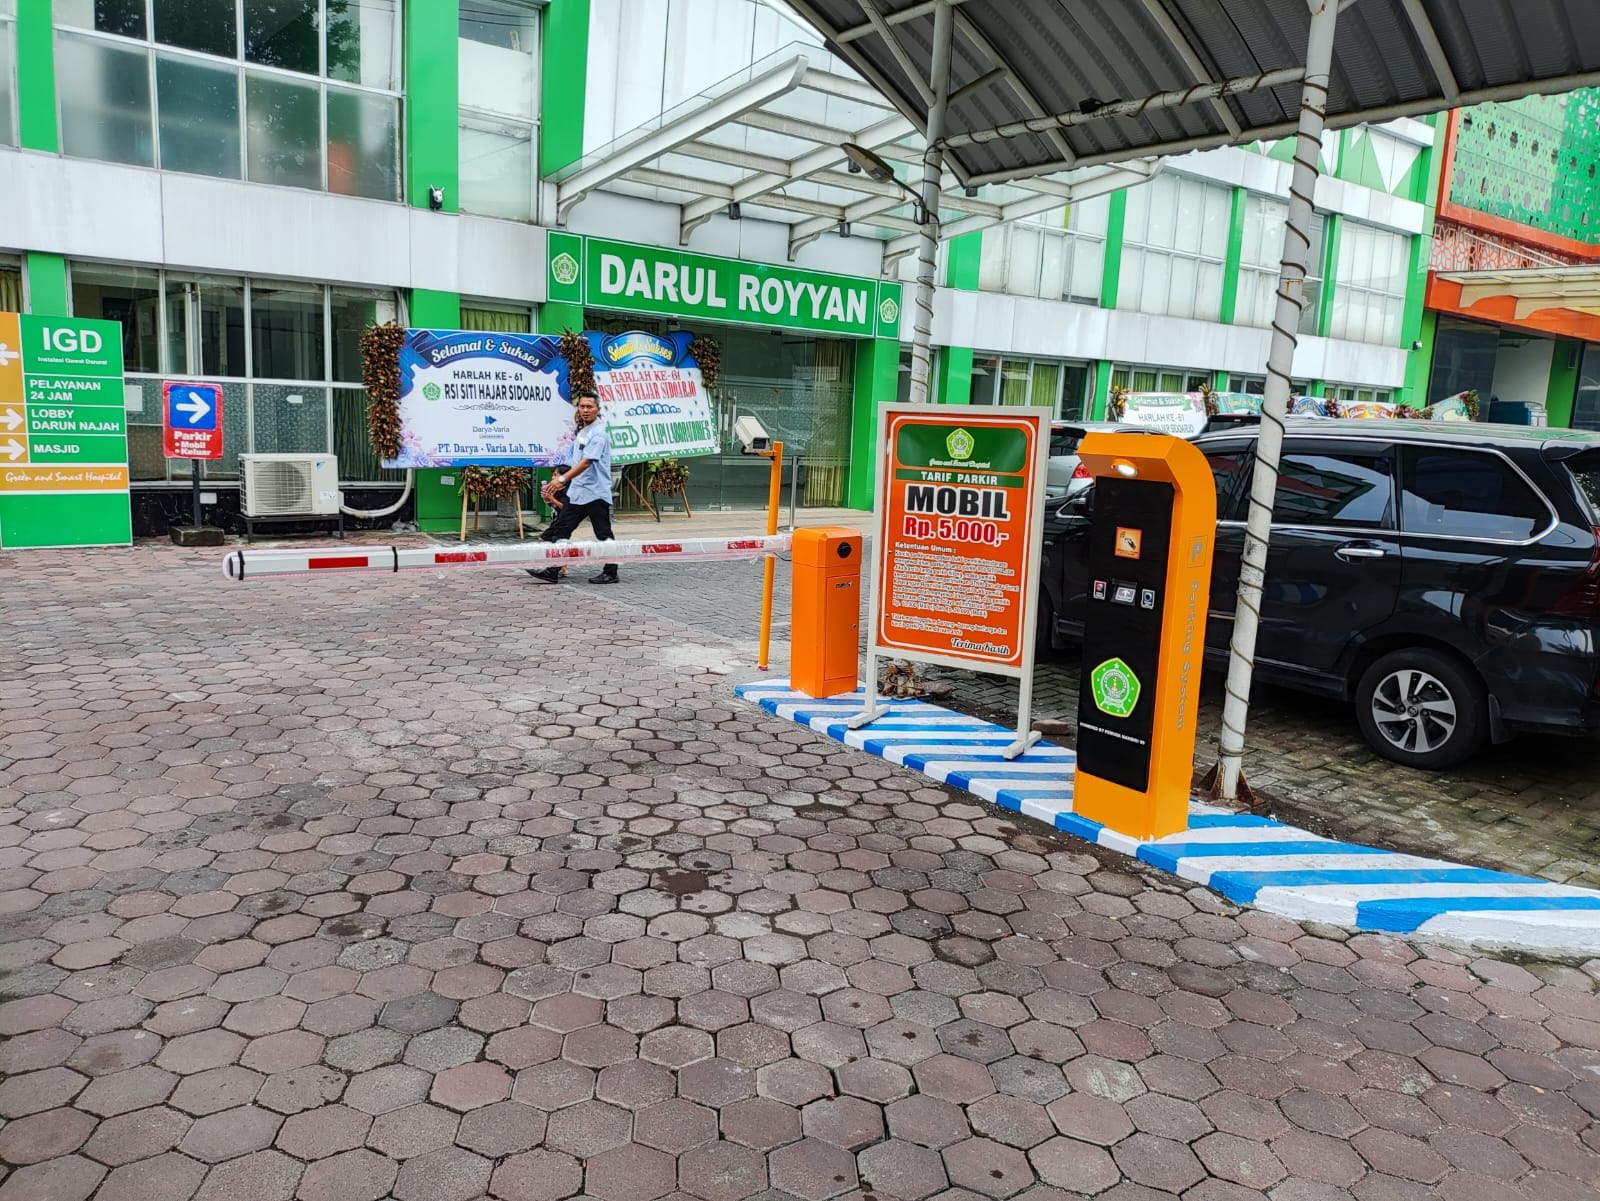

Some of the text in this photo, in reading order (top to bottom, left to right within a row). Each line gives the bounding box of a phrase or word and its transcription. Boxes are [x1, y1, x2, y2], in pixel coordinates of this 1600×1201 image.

[600, 252, 868, 325] DARUL ROYYAN
[42, 327, 103, 353] IGD
[431, 338, 540, 367] Selamat & Sukses
[646, 338, 673, 361] Sukses
[453, 370, 491, 380] HARLAH
[495, 371, 507, 381] KE
[514, 372, 523, 381] 61
[609, 371, 652, 383] HARLAH
[30, 379, 101, 391] PELAYANAN
[598, 380, 697, 402] RSI SITI HAJAR SIDOARJO
[30, 391, 73, 401] 24 JAM
[444, 383, 551, 401] RSI SITI HAJAR SIDOARJO
[31, 409, 74, 419] LOBBY
[1138, 413, 1165, 421] HARLAH
[32, 421, 119, 431] DARUN NAJAH
[173, 431, 213, 442] Parkir
[33, 444, 80, 454] MASJID
[180, 448, 212, 456] Keluar
[454, 444, 478, 455] Darya
[486, 443, 507, 453] Varia
[528, 443, 544, 453] Tbk
[5, 471, 122, 483] Green and Smart Hospital
[920, 471, 998, 485] TARIF PARKIR
[905, 484, 1009, 520] MOBIL
[904, 516, 1009, 544] Rp. 5.000,-
[1192, 541, 1203, 562] P
[1182, 580, 1200, 655] Parking
[951, 638, 982, 650] Terima
[1177, 661, 1191, 731] System
